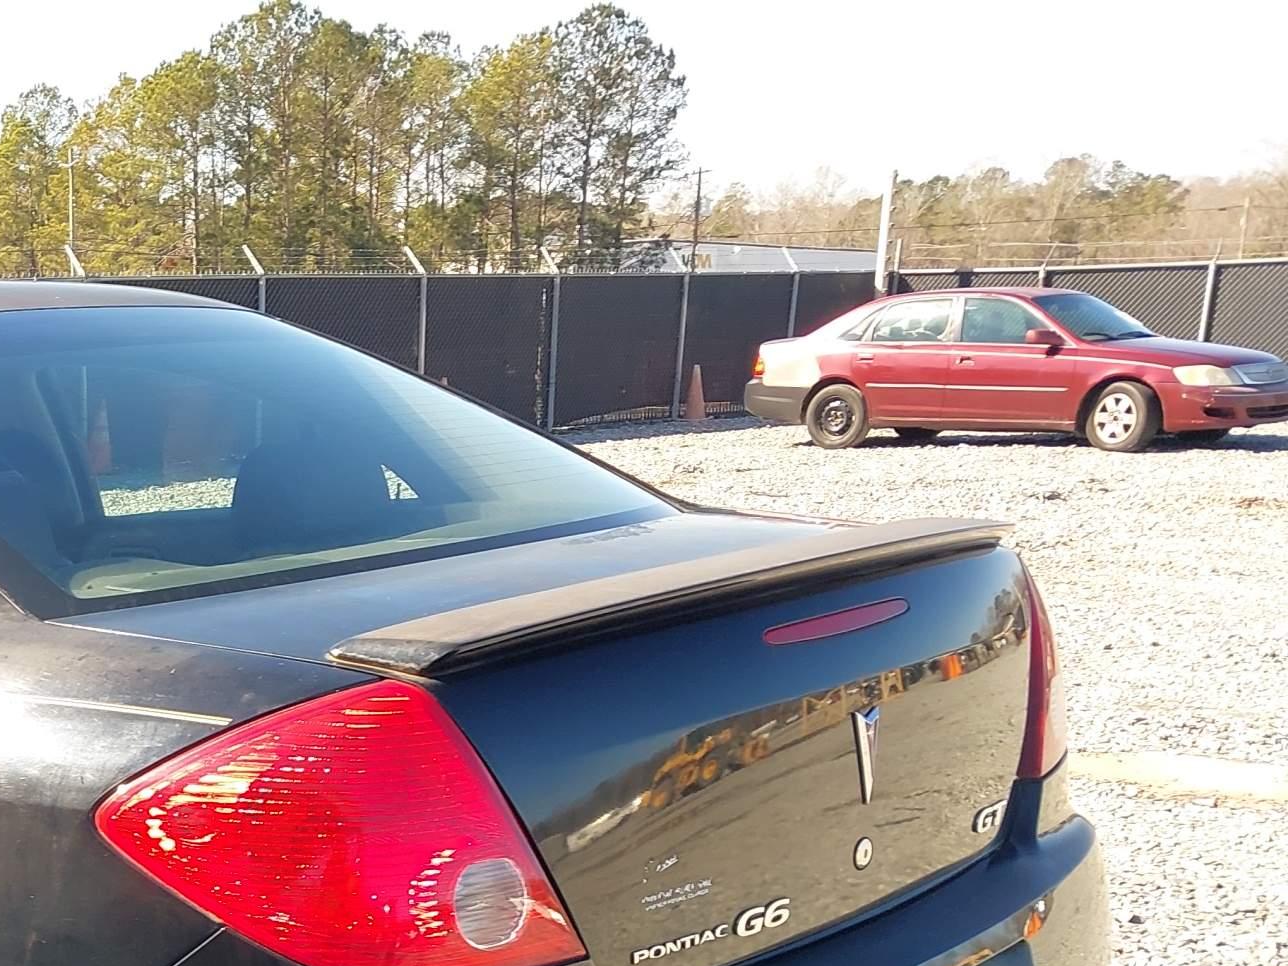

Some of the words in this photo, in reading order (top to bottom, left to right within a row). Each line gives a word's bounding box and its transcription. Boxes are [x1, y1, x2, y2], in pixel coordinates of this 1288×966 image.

[973, 799, 1008, 833] GT
[631, 924, 729, 965] PONTIAC
[733, 897, 790, 937] G6
